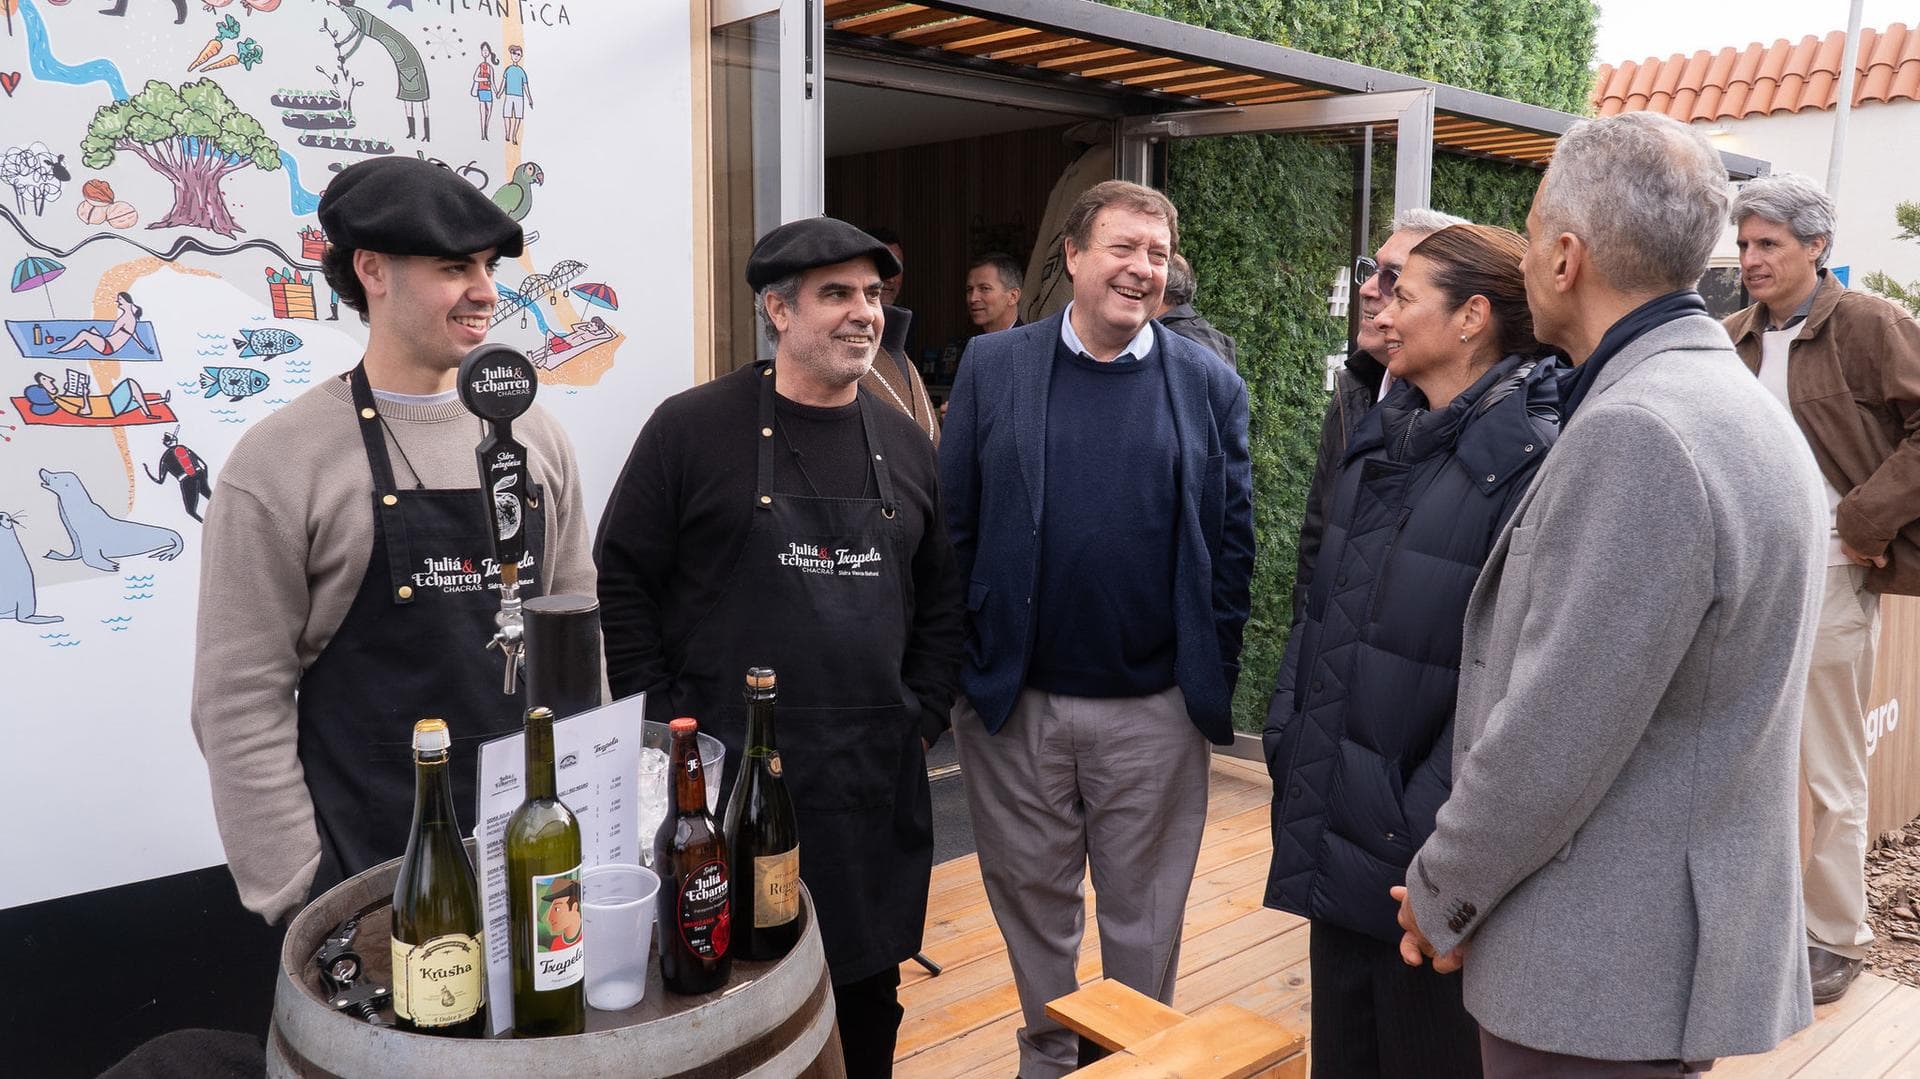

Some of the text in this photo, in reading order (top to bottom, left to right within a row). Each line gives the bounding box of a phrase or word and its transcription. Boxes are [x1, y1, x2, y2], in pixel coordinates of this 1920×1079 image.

[482, 366, 513, 382] Juliá
[472, 379, 530, 393] Echarren
[497, 389, 531, 397] CHACRAS
[788, 542, 818, 557] Juliá
[424, 557, 477, 575] Juliá &
[481, 550, 535, 577] Txela
[778, 553, 834, 569] Echarren
[835, 547, 882, 569] Txapela
[412, 572, 482, 587] Echarren
[443, 584, 482, 593] CHACRAS
[1862, 697, 1899, 757] gro
[695, 872, 721, 892] Juliá
[420, 964, 472, 982] Krusha
